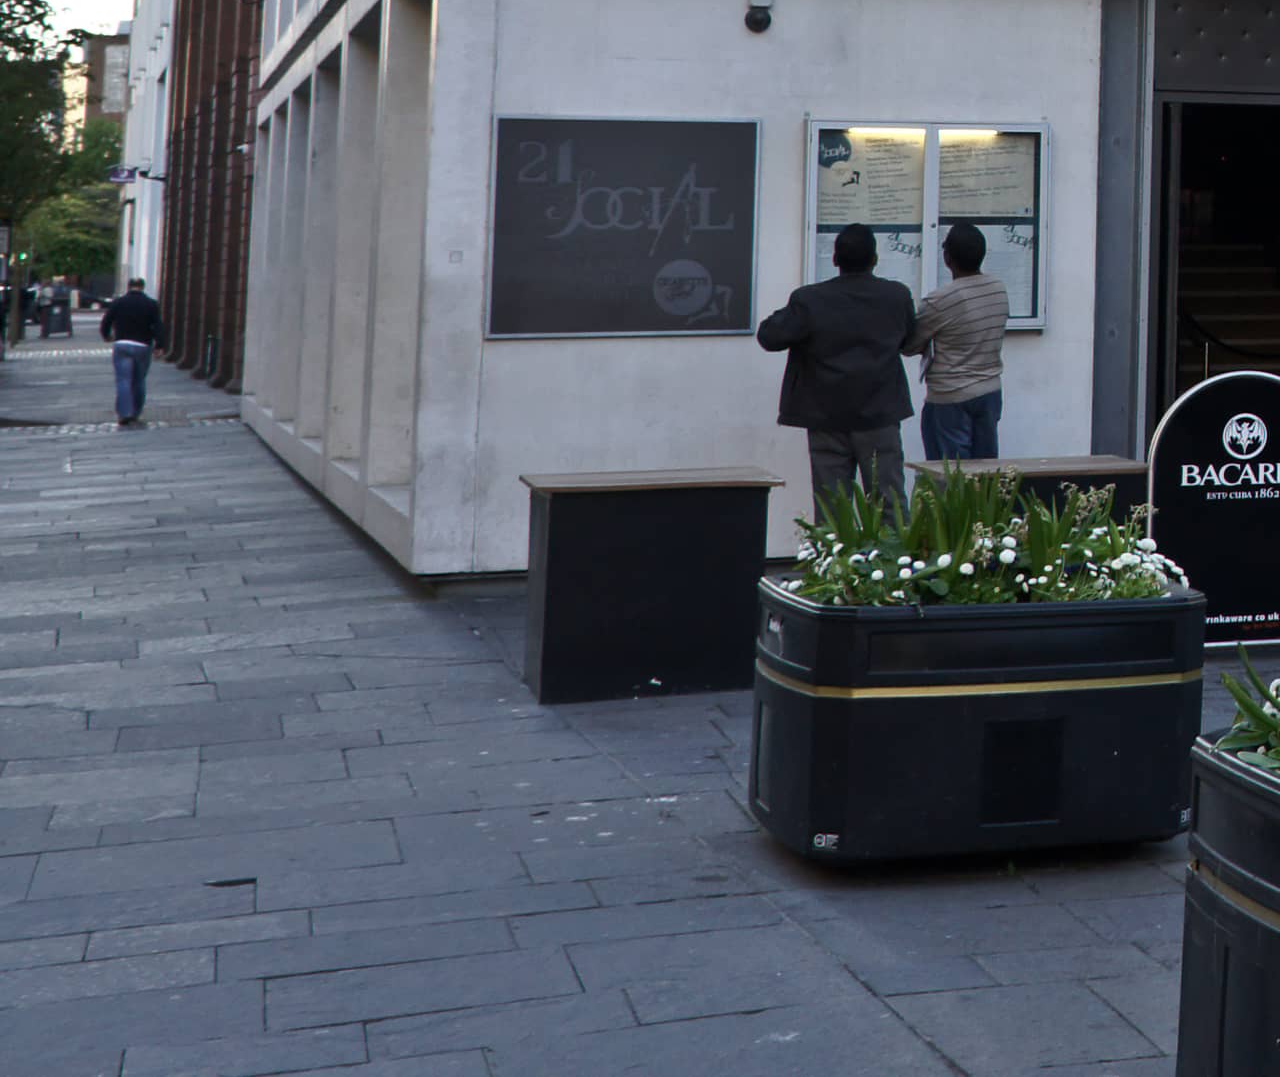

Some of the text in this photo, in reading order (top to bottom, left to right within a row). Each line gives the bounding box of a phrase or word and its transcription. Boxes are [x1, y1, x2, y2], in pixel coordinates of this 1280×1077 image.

[517, 138, 575, 183] 21
[1229, 490, 1252, 499] CUBA
[1254, 487, 1280, 499] 1862
